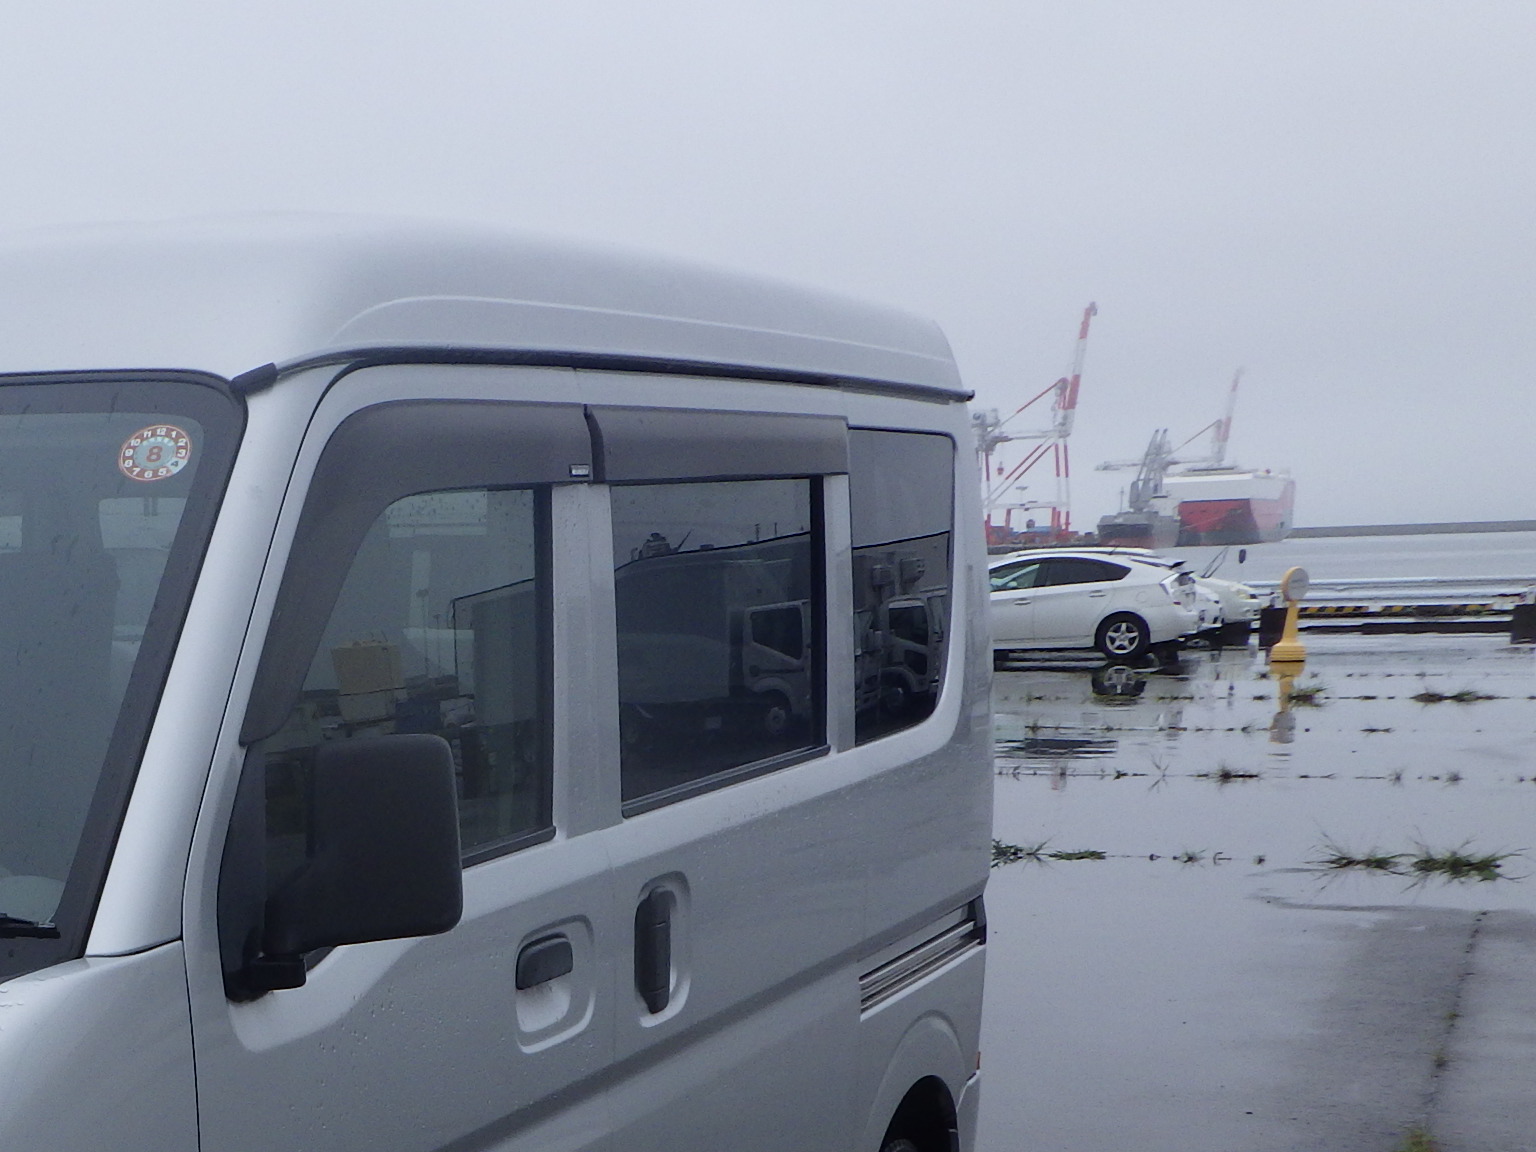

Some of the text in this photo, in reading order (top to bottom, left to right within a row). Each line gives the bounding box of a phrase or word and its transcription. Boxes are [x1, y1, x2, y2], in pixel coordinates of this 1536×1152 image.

[156, 428, 167, 436] 12
[130, 438, 141, 446] 10
[177, 438, 186, 446] 2
[124, 449, 134, 457] 9
[146, 446, 163, 462] 8
[177, 449, 186, 457] 3
[124, 459, 133, 467] 8
[132, 468, 141, 476] 7
[144, 470, 153, 478] 6
[158, 468, 167, 476] 5
